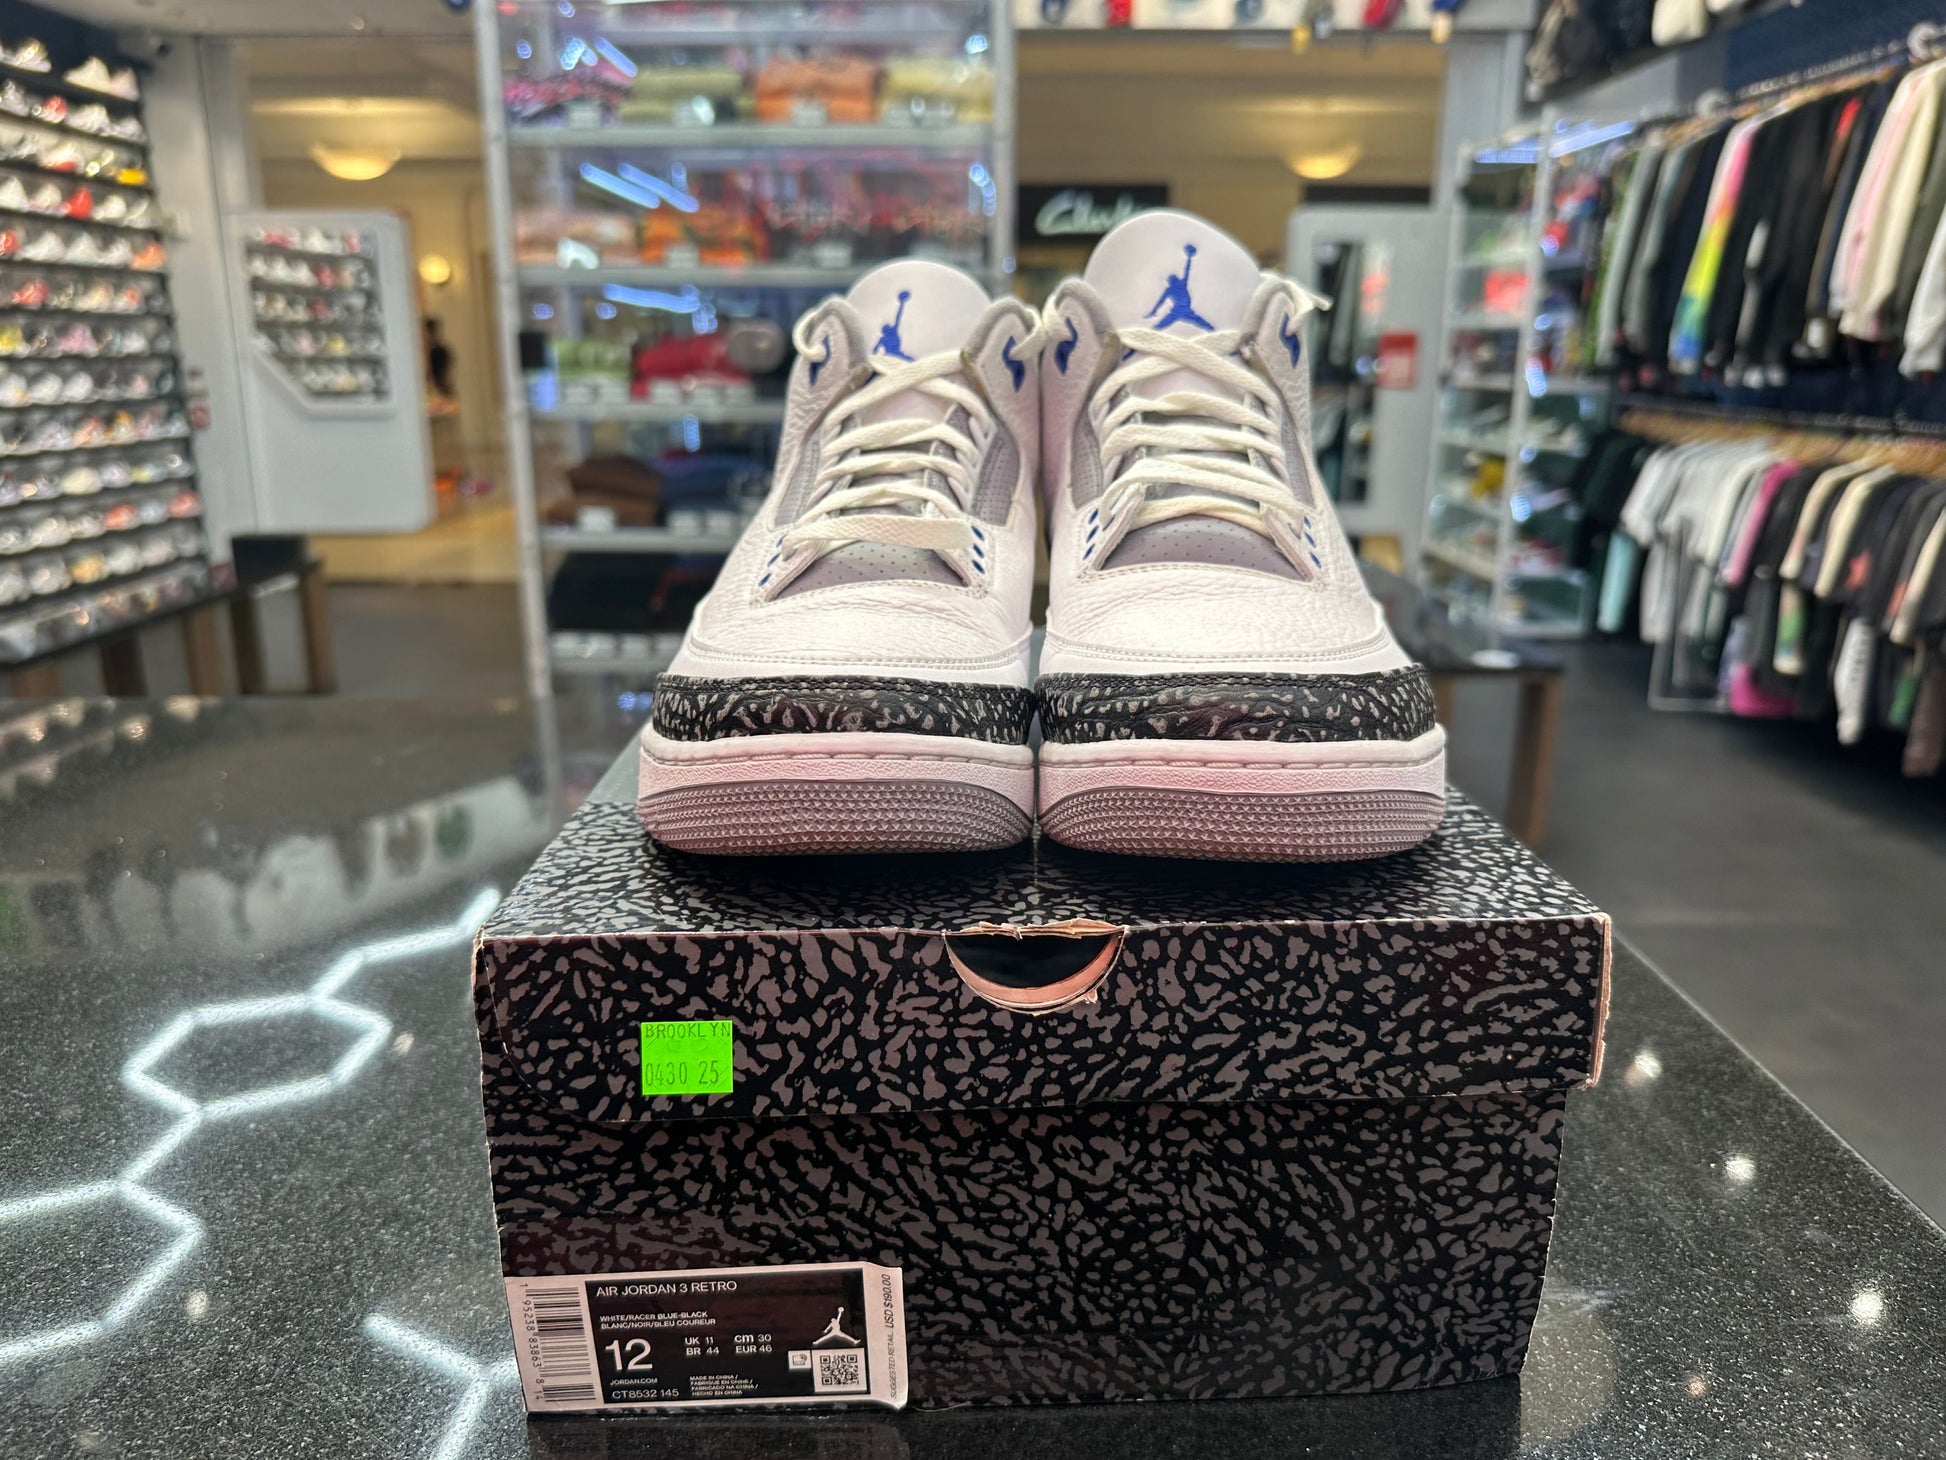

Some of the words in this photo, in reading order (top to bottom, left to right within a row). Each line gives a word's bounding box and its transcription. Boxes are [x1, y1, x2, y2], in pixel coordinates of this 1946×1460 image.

[645, 1022, 730, 1038] BROOKLYN
[698, 1059, 719, 1085] 25
[596, 1285, 619, 1297] AIR
[621, 1283, 676, 1296] JORDAN
[679, 1283, 688, 1293] 3
[691, 1280, 738, 1292] RETRO
[881, 1274, 893, 1308] $190.00
[600, 1314, 656, 1322] WHITE/RACER
[657, 1311, 708, 1320] BLUE-BLACK
[883, 1309, 895, 1329] USD
[600, 1320, 675, 1330] BLANC/NOIR/BLEU
[676, 1318, 717, 1327] COUREUR
[522, 1299, 535, 1331] 95238
[529, 1337, 542, 1368] 83863
[685, 1337, 700, 1345] UK
[704, 1336, 714, 1345] 11
[734, 1334, 754, 1343] cm
[757, 1333, 772, 1343] 30
[605, 1338, 653, 1370] 12
[686, 1346, 702, 1356] BR
[706, 1346, 720, 1355] 44
[735, 1345, 757, 1354] EUR
[759, 1344, 773, 1353] 46
[610, 1378, 658, 1386] JORDAN.COM
[888, 1356, 897, 1398] SUGGESTED
[612, 1389, 657, 1399] CT8532
[661, 1388, 679, 1397] 145
